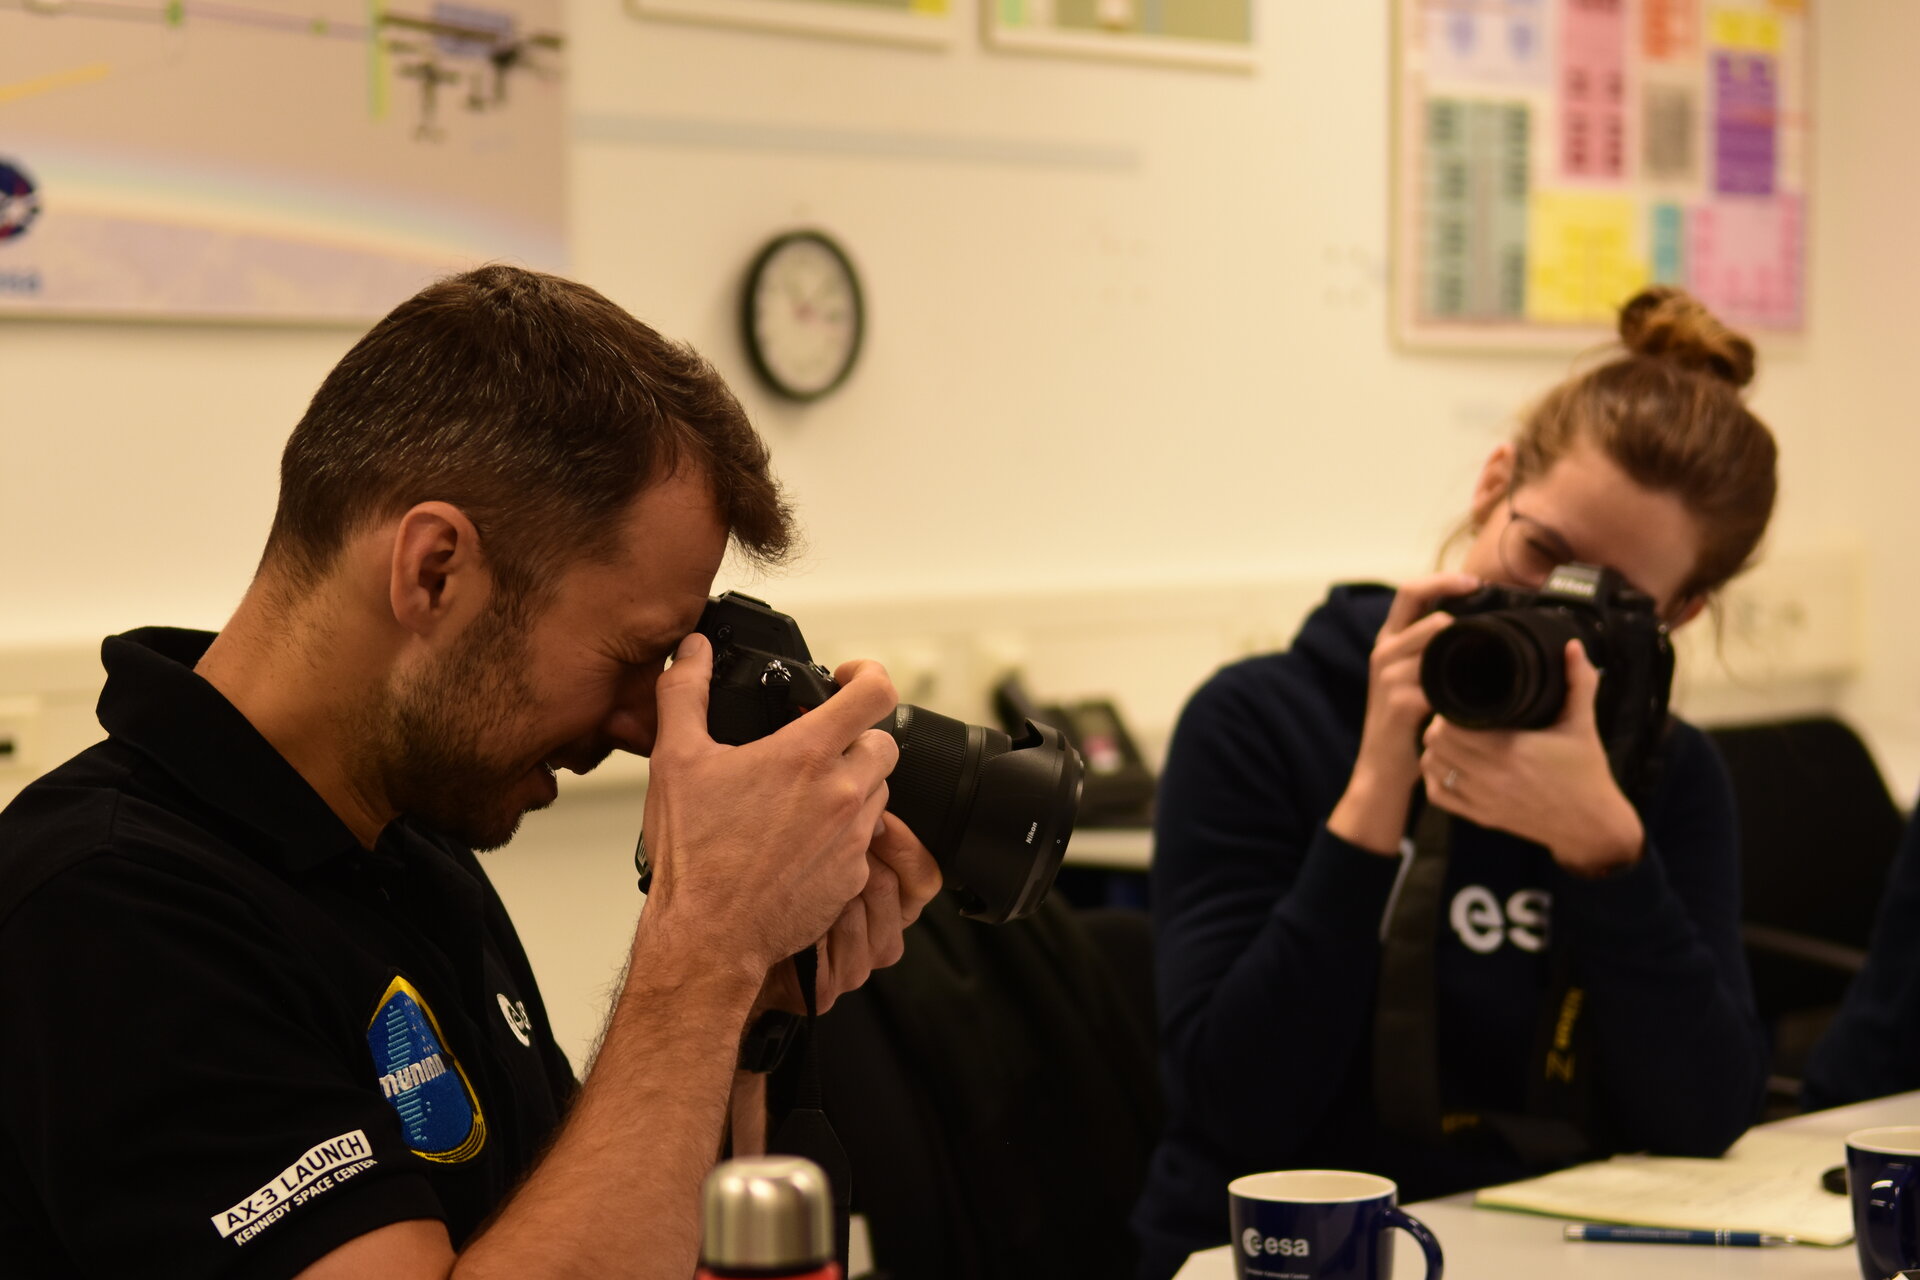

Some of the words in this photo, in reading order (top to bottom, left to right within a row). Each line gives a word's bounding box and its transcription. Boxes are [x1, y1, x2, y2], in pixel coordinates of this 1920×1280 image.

[1025, 821, 1038, 844] Nikon
[1450, 885, 1552, 953] es
[226, 1188, 278, 1229] AX-3
[280, 1134, 365, 1192] LAUNCH
[233, 1201, 291, 1246] KENNEDY
[293, 1176, 335, 1206] SPACE
[333, 1158, 378, 1183] CENTER
[1264, 1237, 1309, 1257] esa
